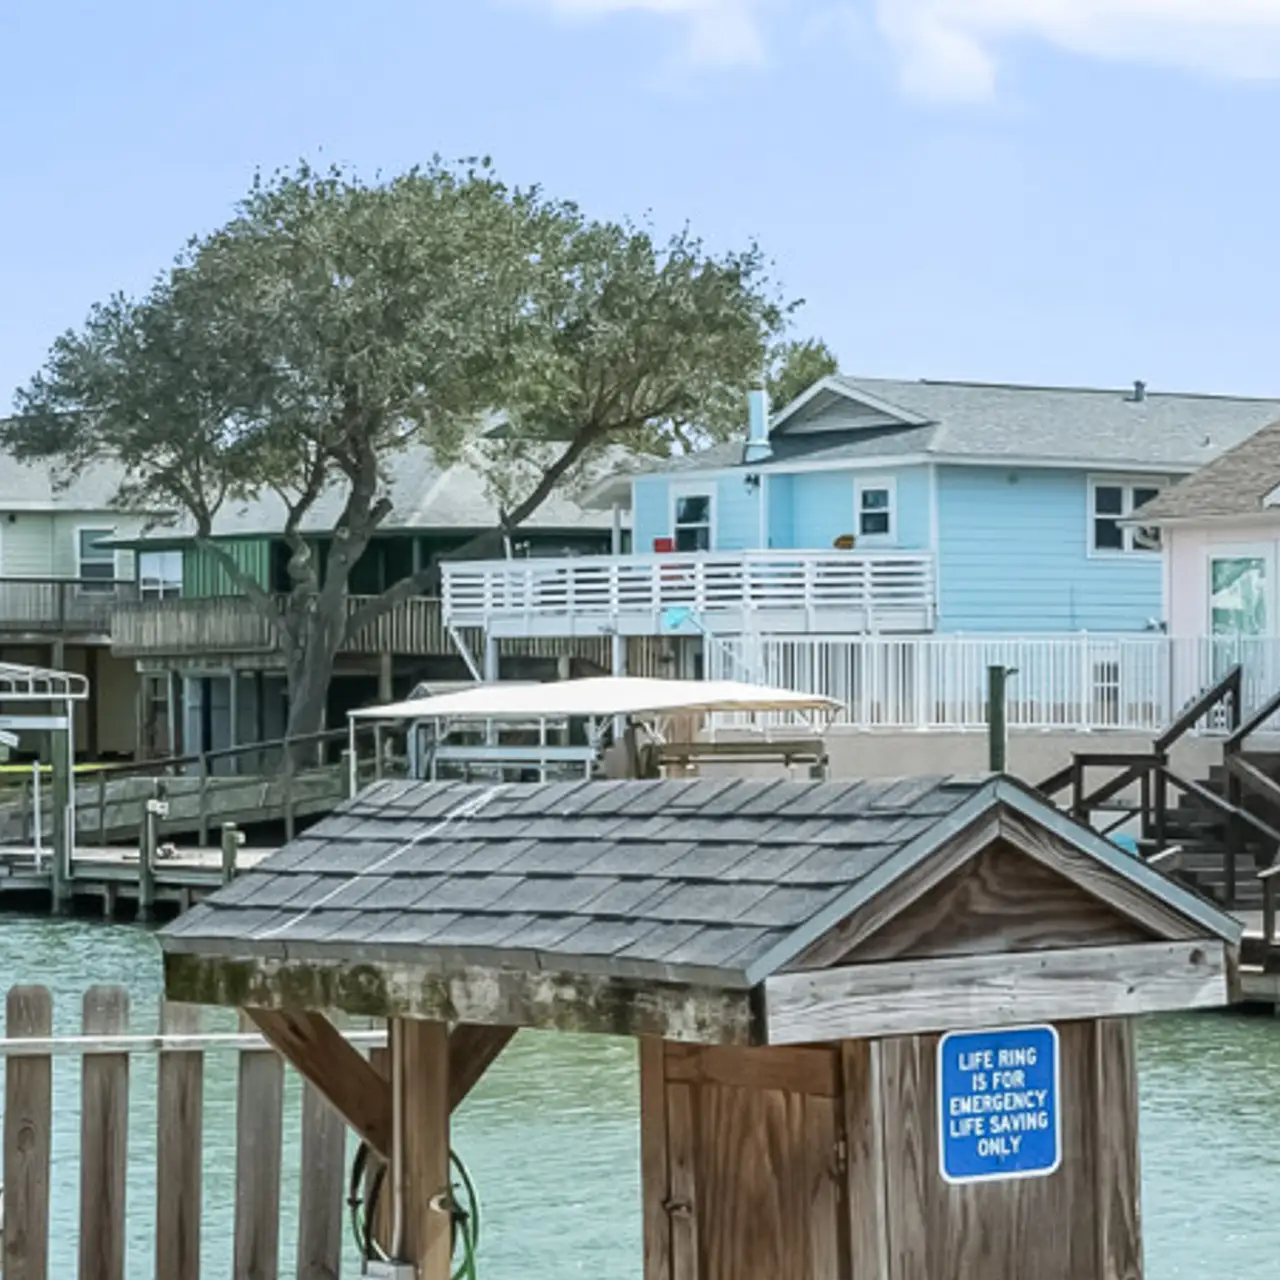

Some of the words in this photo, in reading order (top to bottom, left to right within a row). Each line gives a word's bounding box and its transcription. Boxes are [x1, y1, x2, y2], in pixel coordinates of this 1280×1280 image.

[958, 1050, 993, 1070] LIFE
[998, 1047, 1037, 1067] RING
[972, 1072, 988, 1091] IS
[992, 1070, 1025, 1090] FOR
[950, 1090, 1047, 1115] EMERGENCY
[950, 1118, 984, 1137] LIFE
[990, 1112, 1048, 1133] SAVING
[978, 1135, 1021, 1156] ONLY
